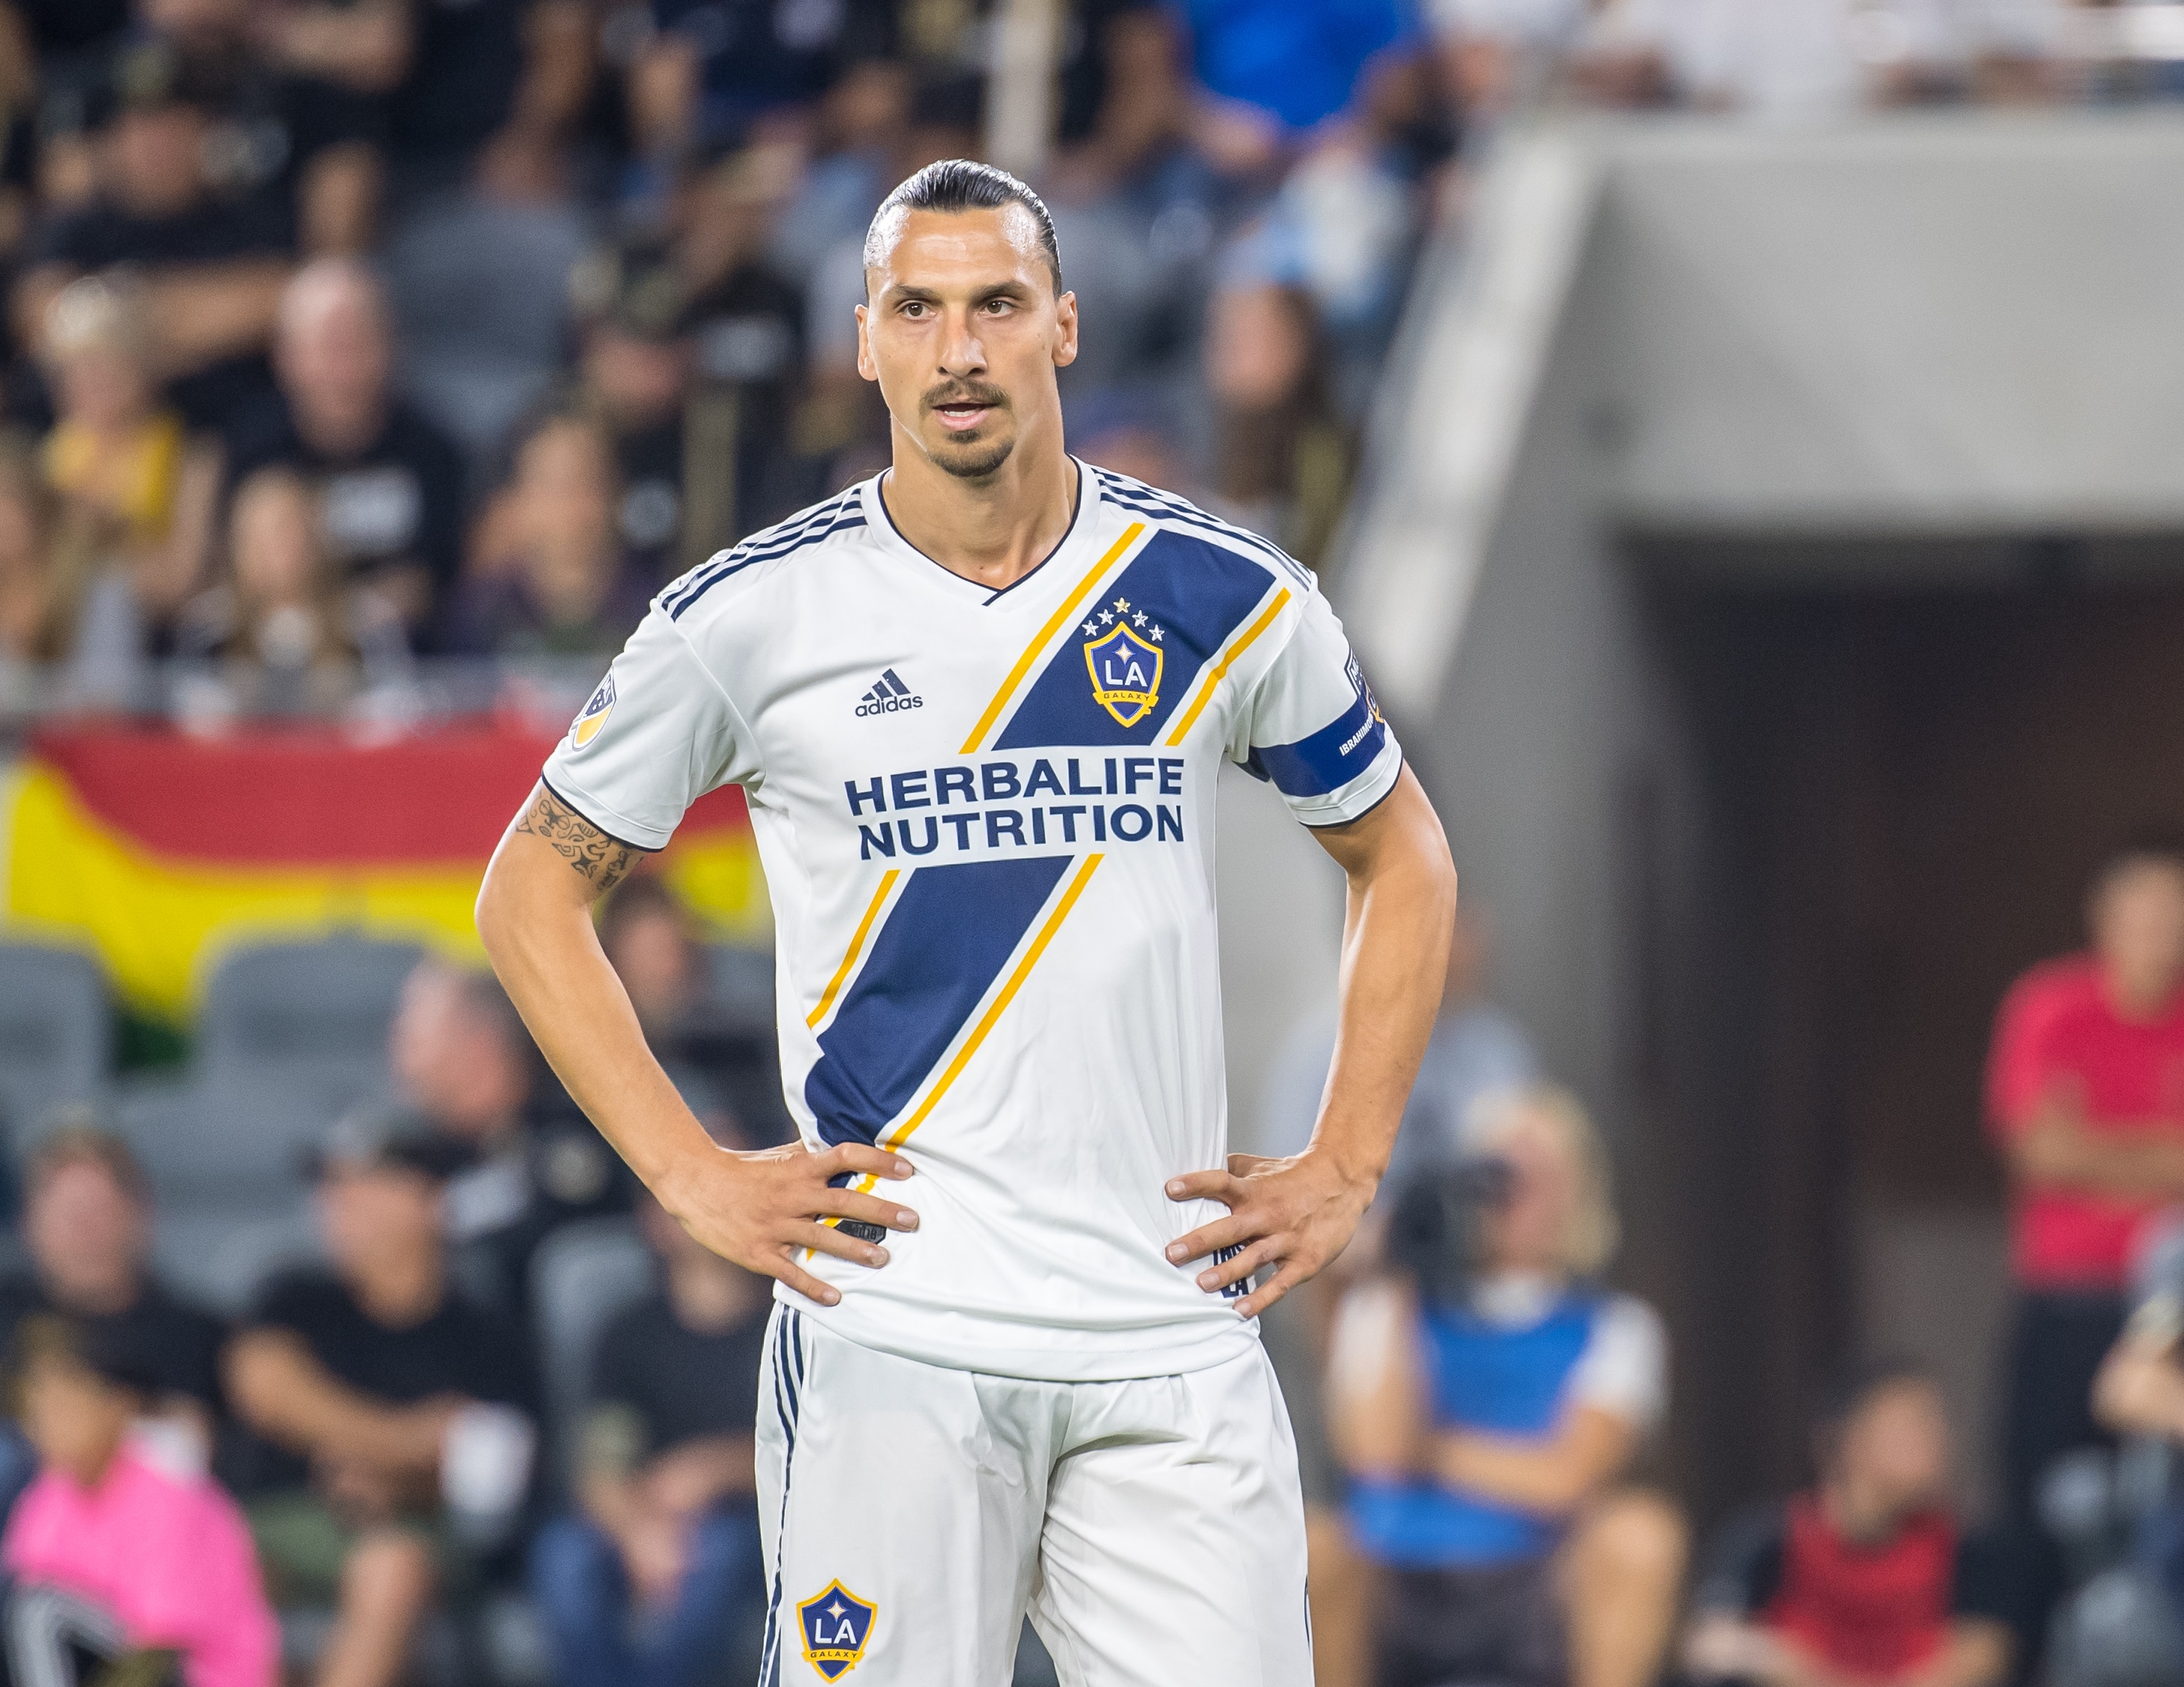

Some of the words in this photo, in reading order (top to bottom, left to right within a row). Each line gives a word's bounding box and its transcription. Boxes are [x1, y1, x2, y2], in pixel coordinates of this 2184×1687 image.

[1105, 660, 1148, 687] LA
[854, 694, 924, 718] adidas
[1103, 692, 1150, 702] GALAXY
[844, 758, 1185, 817] HERBALIFE
[857, 804, 1185, 861] NUTRITION
[815, 1617, 857, 1644] LA
[810, 1650, 858, 1659] GALAXY
